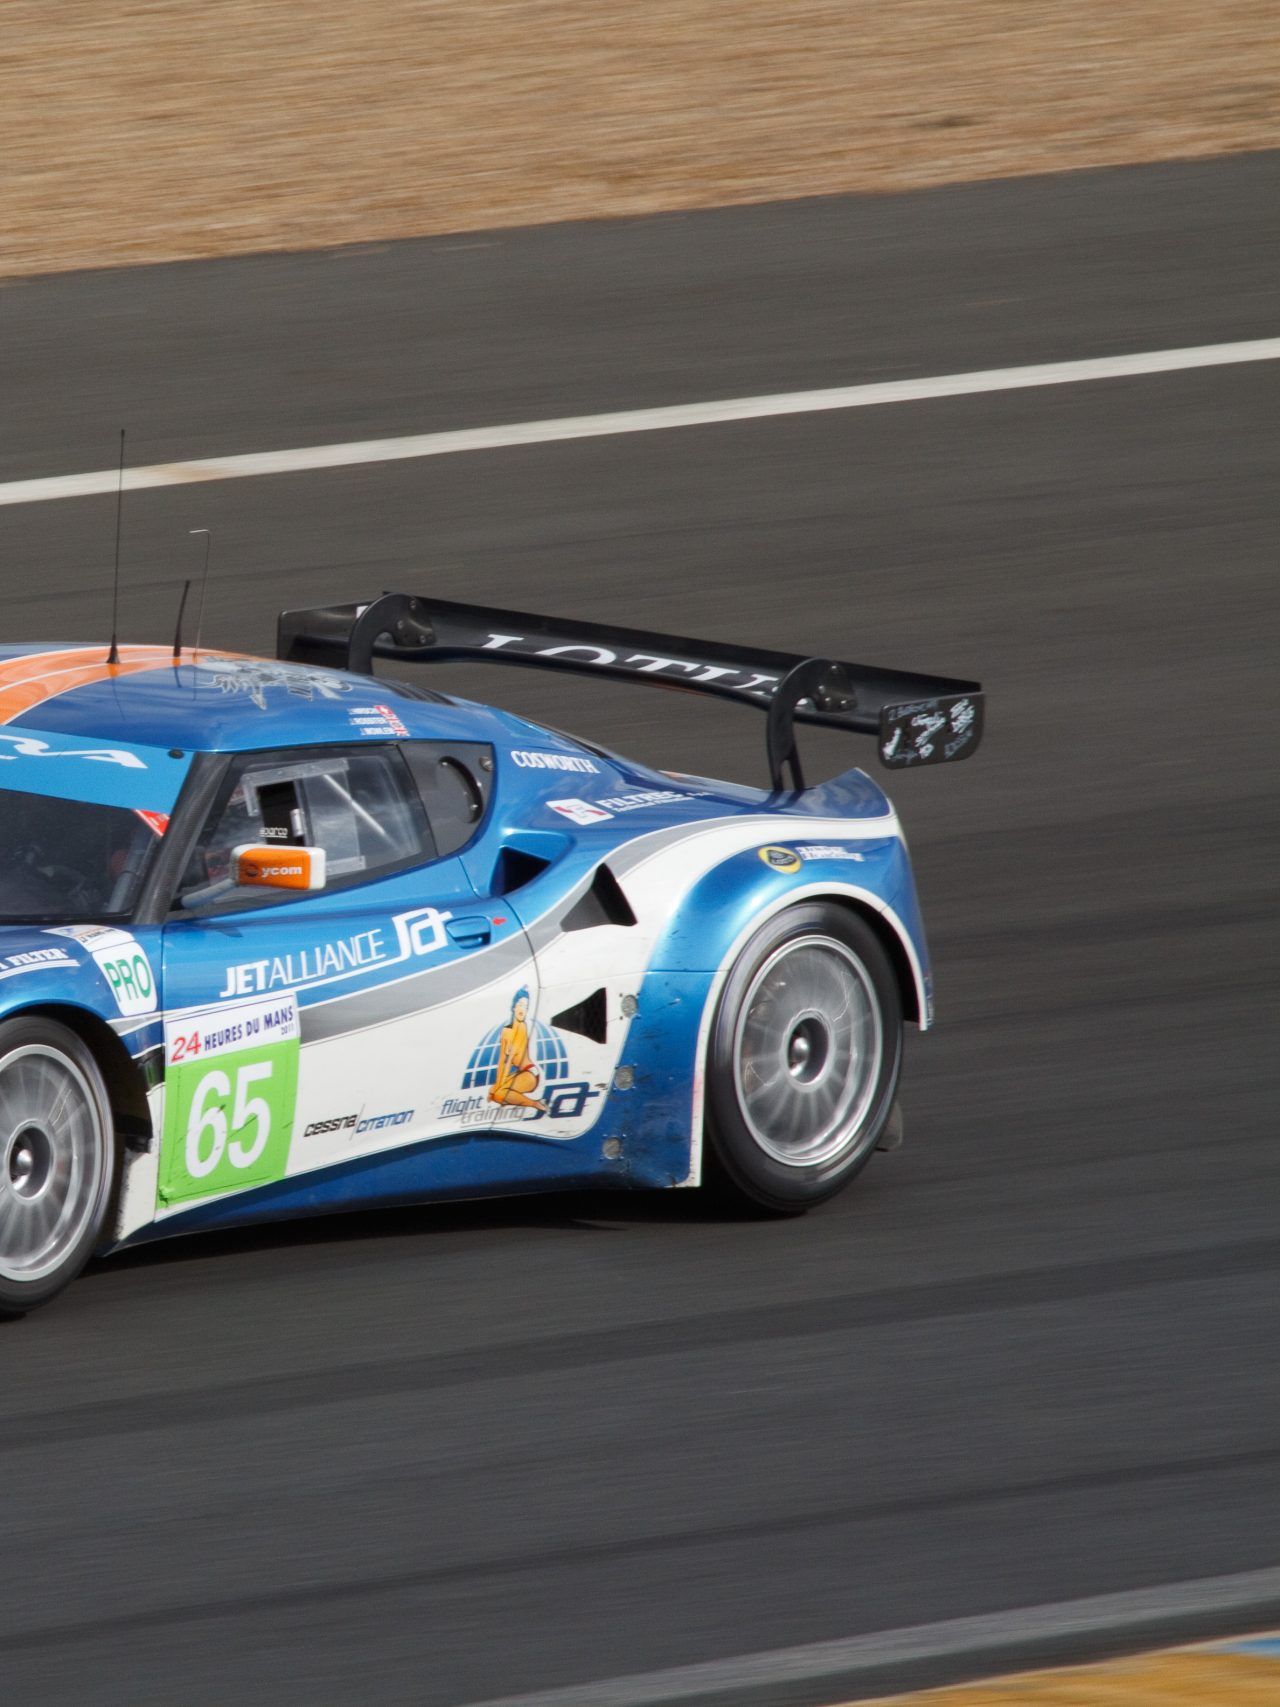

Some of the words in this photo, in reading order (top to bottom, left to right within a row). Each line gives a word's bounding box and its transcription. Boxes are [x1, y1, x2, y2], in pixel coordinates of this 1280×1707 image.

[510, 750, 601, 774] COSWORTH
[261, 866, 302, 878] ycom
[5, 948, 69, 967] FILTER
[103, 954, 152, 1003] PRO
[171, 1030, 202, 1063] 24
[204, 1023, 242, 1051] HEURES
[246, 1017, 260, 1037] DU
[264, 1005, 294, 1031] MANS
[185, 1061, 273, 1178] 65
